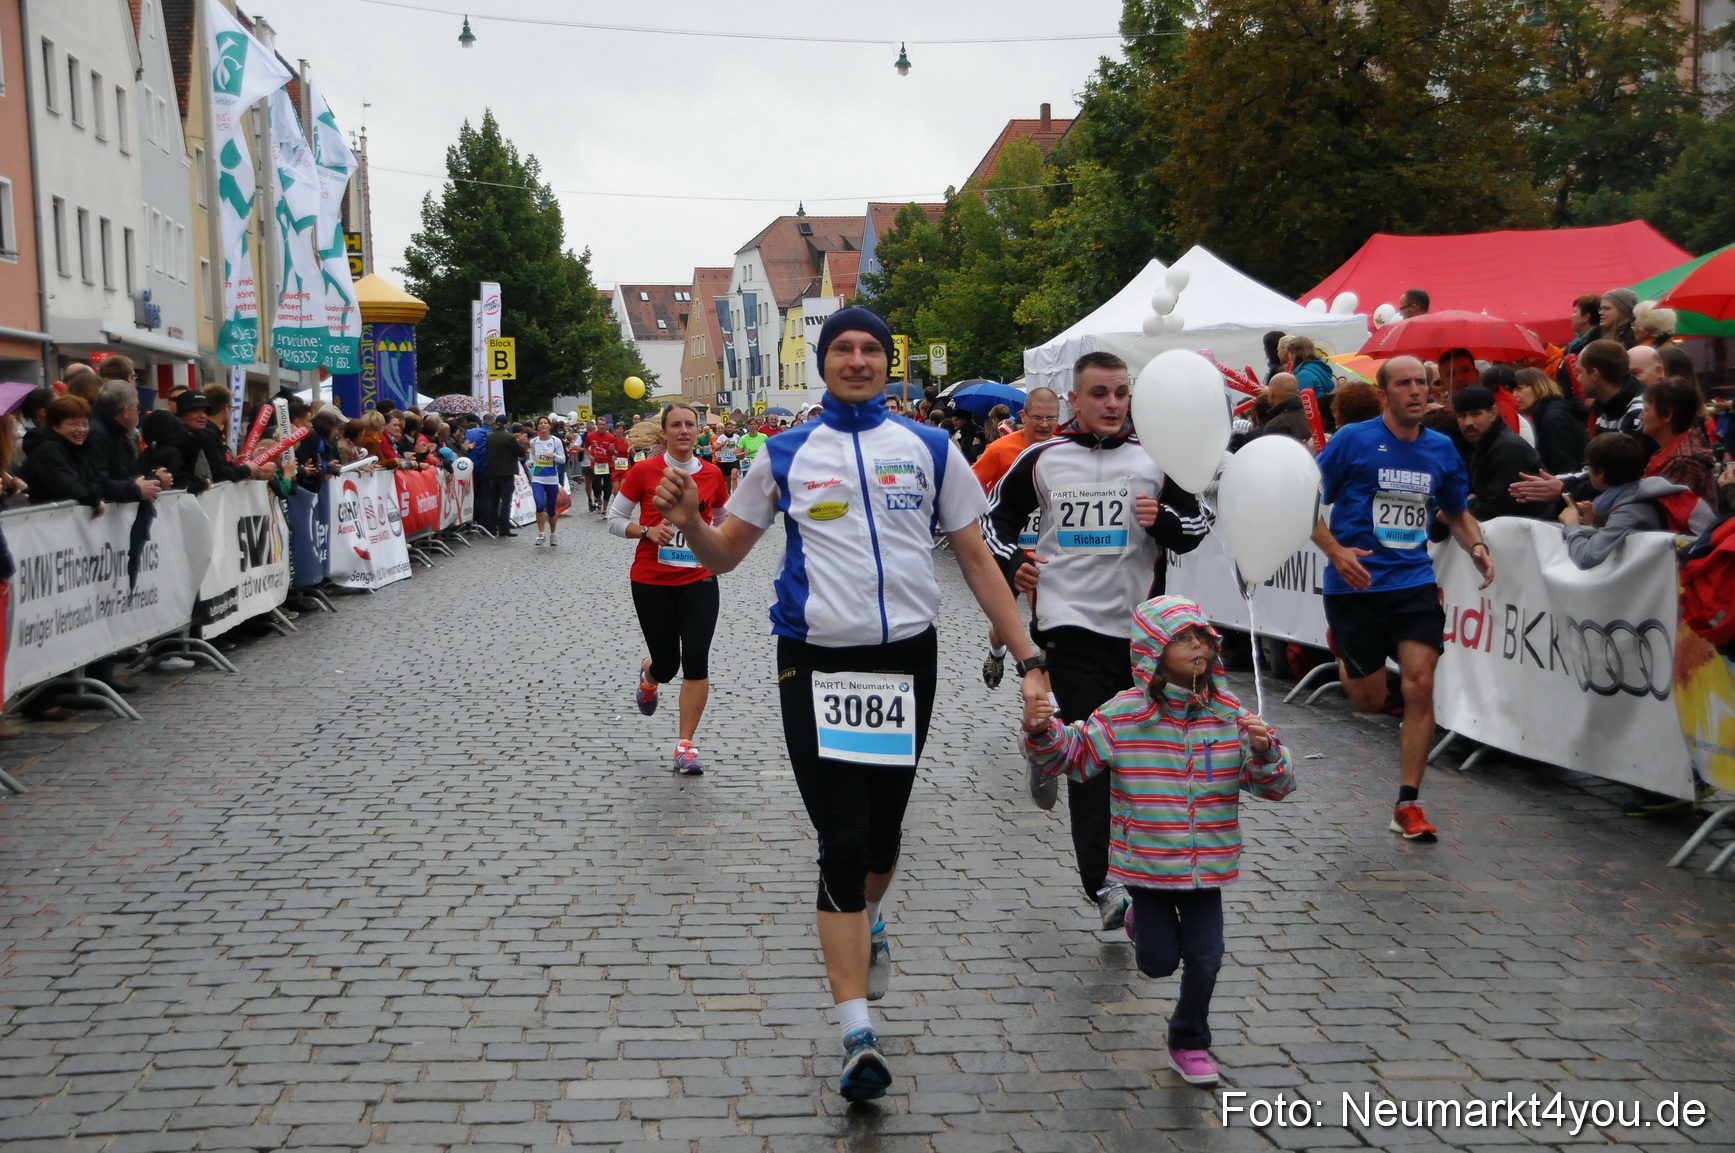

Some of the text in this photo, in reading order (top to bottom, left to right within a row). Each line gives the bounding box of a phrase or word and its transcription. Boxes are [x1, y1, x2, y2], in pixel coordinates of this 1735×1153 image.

[489, 340, 512, 348] Block
[494, 350, 508, 371] B
[580, 410, 587, 420] C
[722, 415, 728, 423] D
[875, 464, 916, 475] PANORAMA
[878, 474, 897, 485] TOUR
[1378, 468, 1432, 486] HUBER
[1390, 483, 1429, 492] TECHNOLOGY
[1052, 489, 1116, 499] PARTL Neumarkt
[1060, 500, 1123, 528] 2712
[1379, 503, 1426, 528] 2768
[1074, 534, 1111, 545] Richard
[20, 552, 52, 605] BMW
[18, 613, 54, 649] Weniger
[1436, 587, 1570, 677] udi BKK
[814, 680, 896, 691] PARTL Neumarkt
[823, 694, 906, 728] 3084
